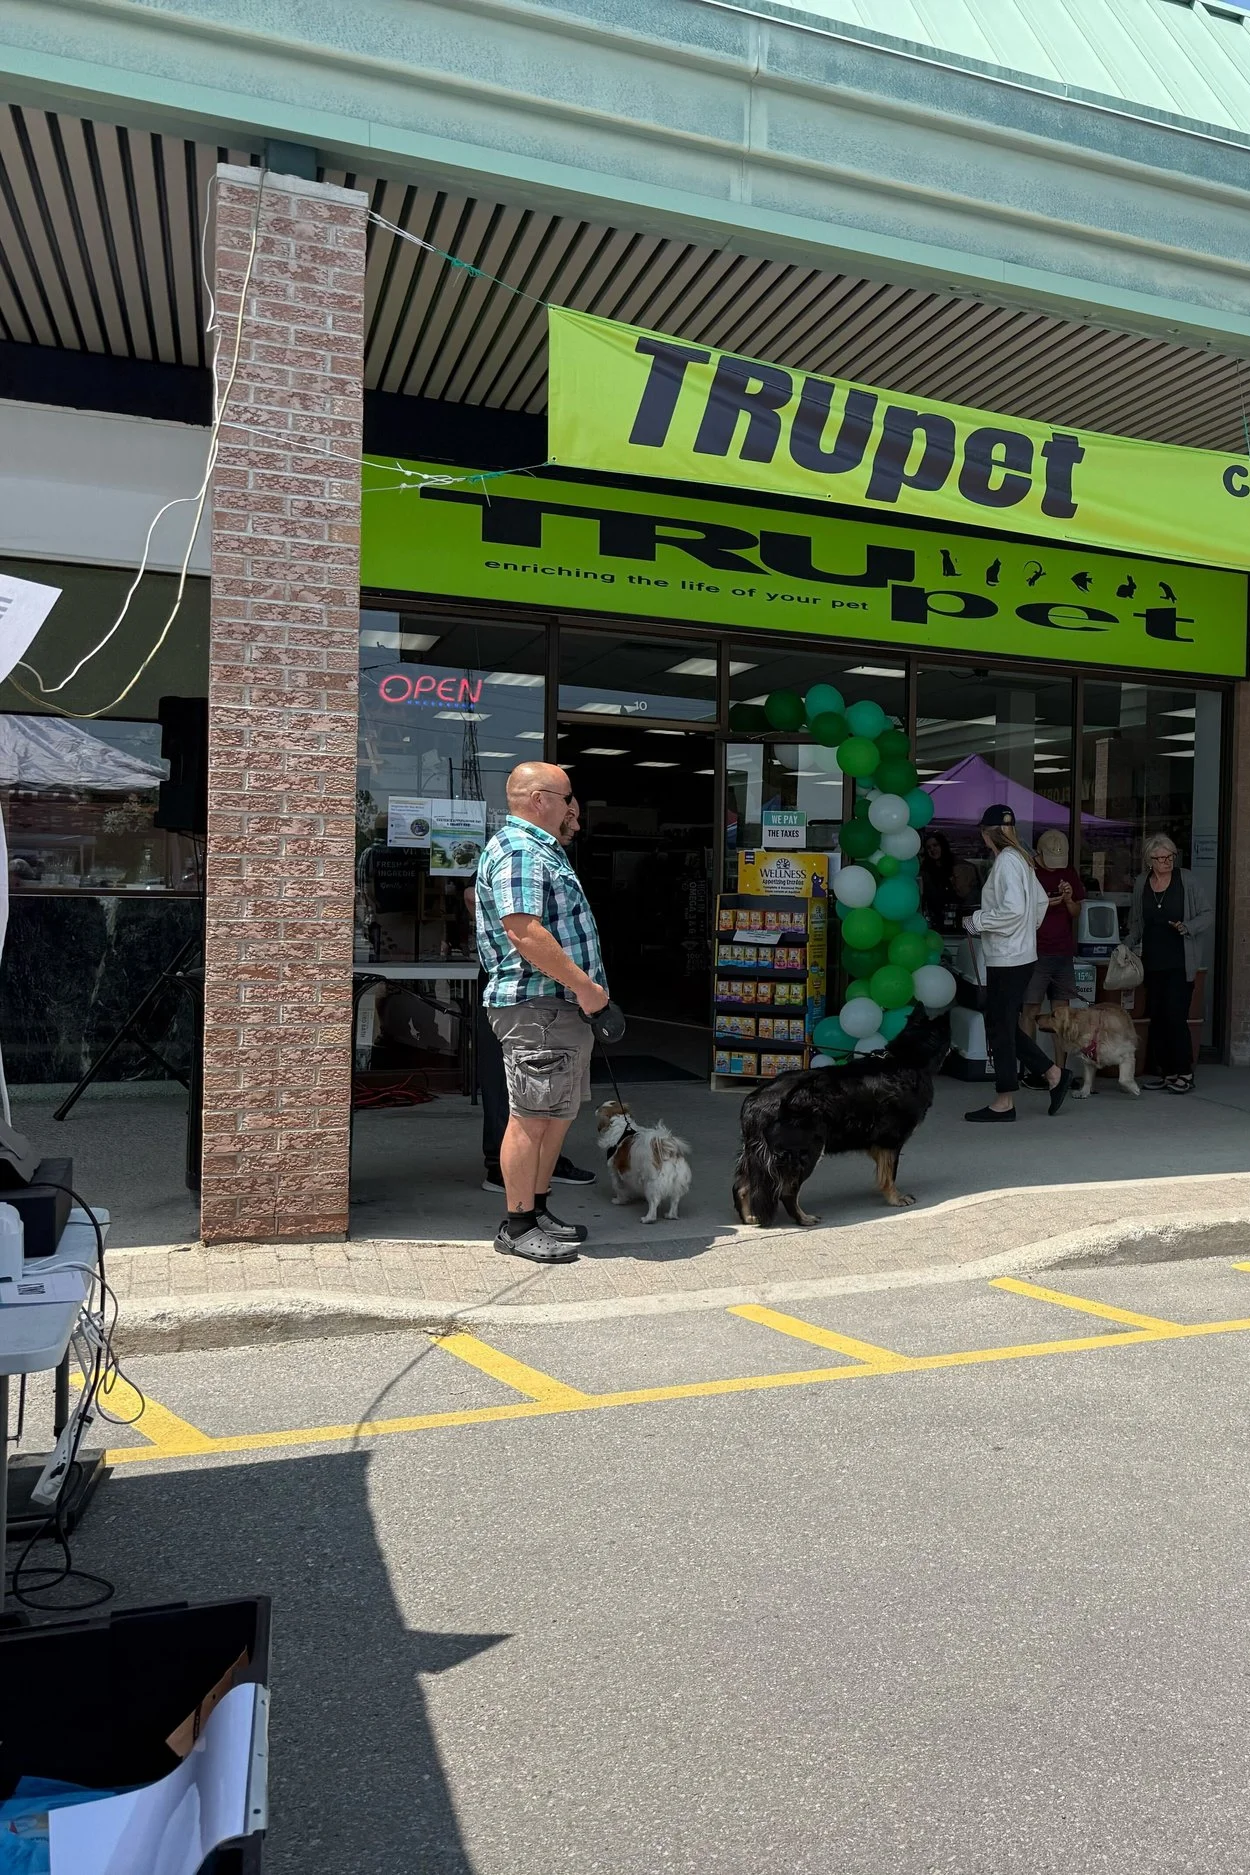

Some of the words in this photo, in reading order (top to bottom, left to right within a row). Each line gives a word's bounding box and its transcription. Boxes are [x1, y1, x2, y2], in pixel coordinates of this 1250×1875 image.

[628, 336, 1086, 519] TRUpet
[485, 558, 617, 583] enriching
[627, 574, 669, 588] the
[681, 580, 721, 594] life
[731, 587, 757, 598] of
[766, 592, 822, 605] your
[831, 598, 869, 612] pet
[378, 674, 483, 703] OPEN
[633, 700, 648, 711] 10
[771, 815, 782, 825] WE
[783, 815, 798, 825] PAY
[767, 829, 779, 837] THE
[781, 829, 800, 838] TAXES
[760, 868, 807, 879] WELLNESS
